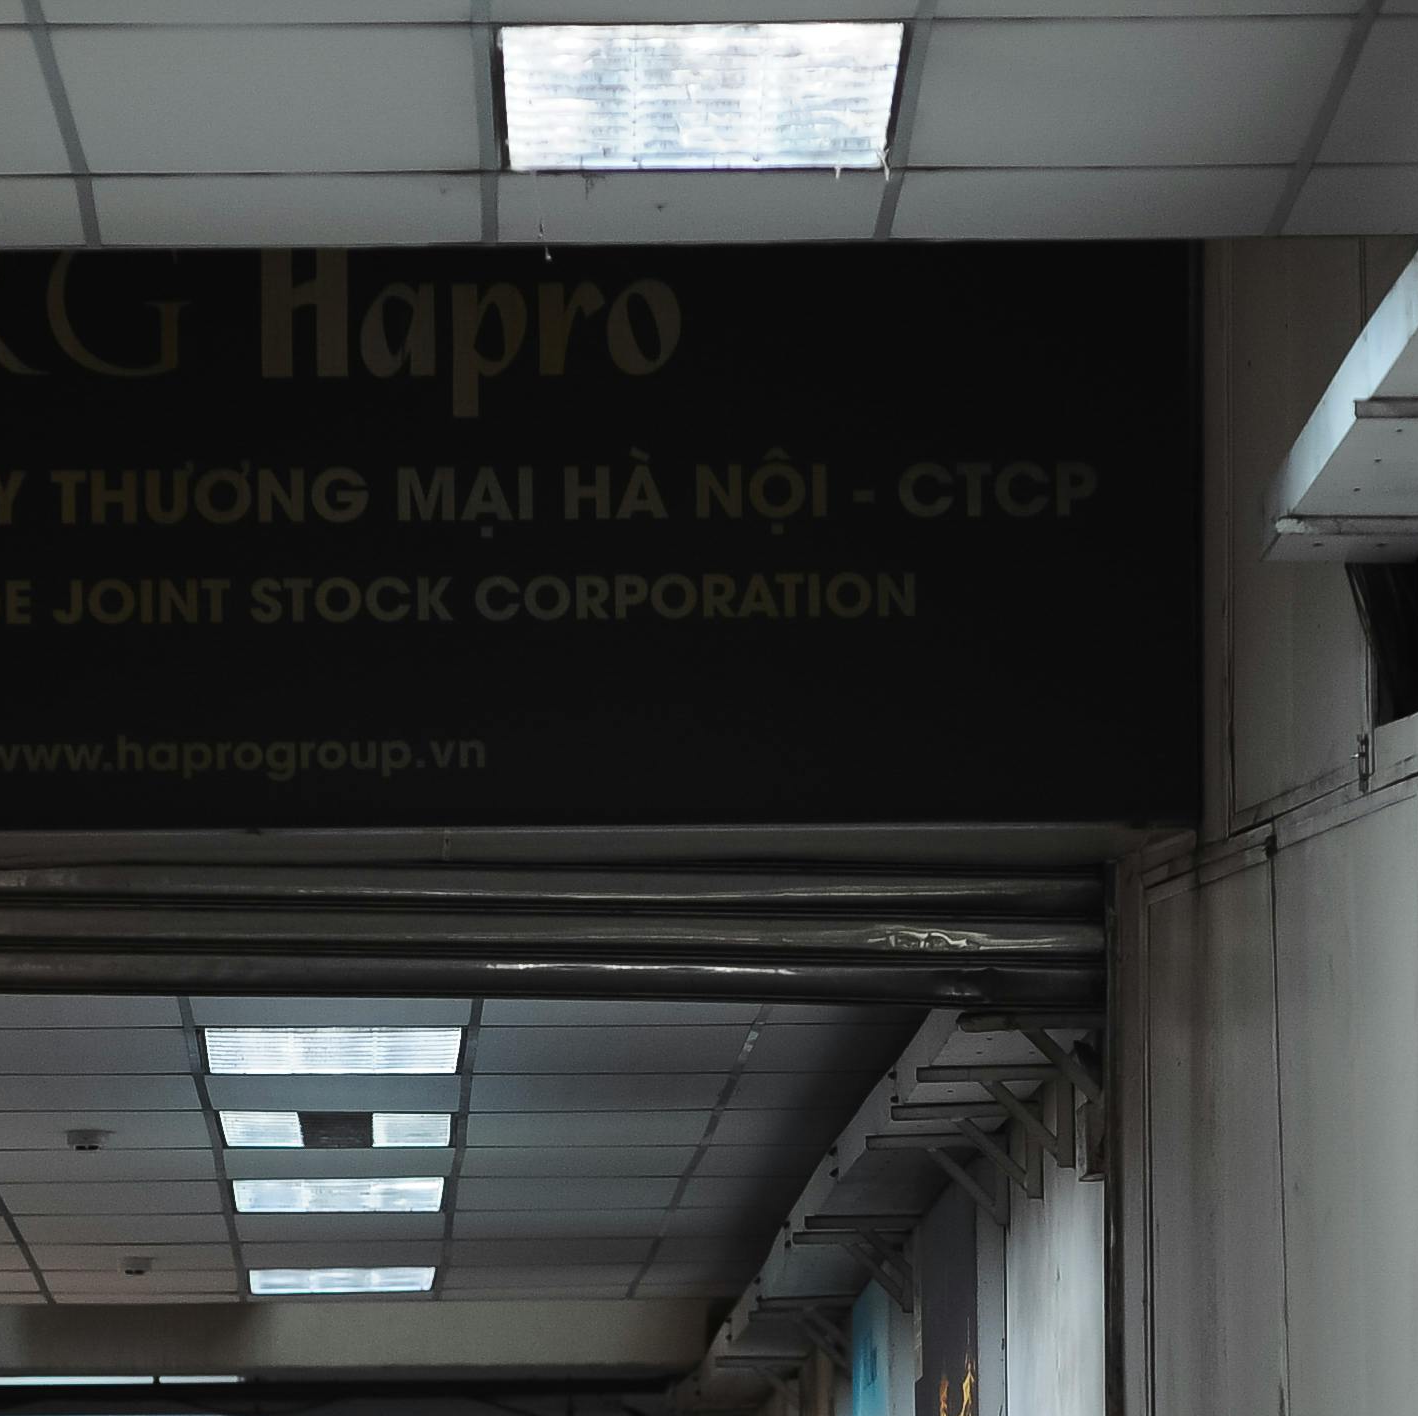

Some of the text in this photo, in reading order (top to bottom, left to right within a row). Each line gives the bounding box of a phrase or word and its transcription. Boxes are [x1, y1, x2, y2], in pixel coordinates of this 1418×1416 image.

[260, 247, 680, 418] Hapro
[50, 459, 370, 526] THƯƠNG
[396, 465, 534, 538] MẠI
[563, 446, 669, 519] HÀ
[694, 447, 828, 535] NỘI
[898, 461, 1098, 517] CTCP
[52, 577, 231, 625] JOINT
[249, 575, 455, 624] STOCK
[474, 571, 917, 622] CORPORATION
